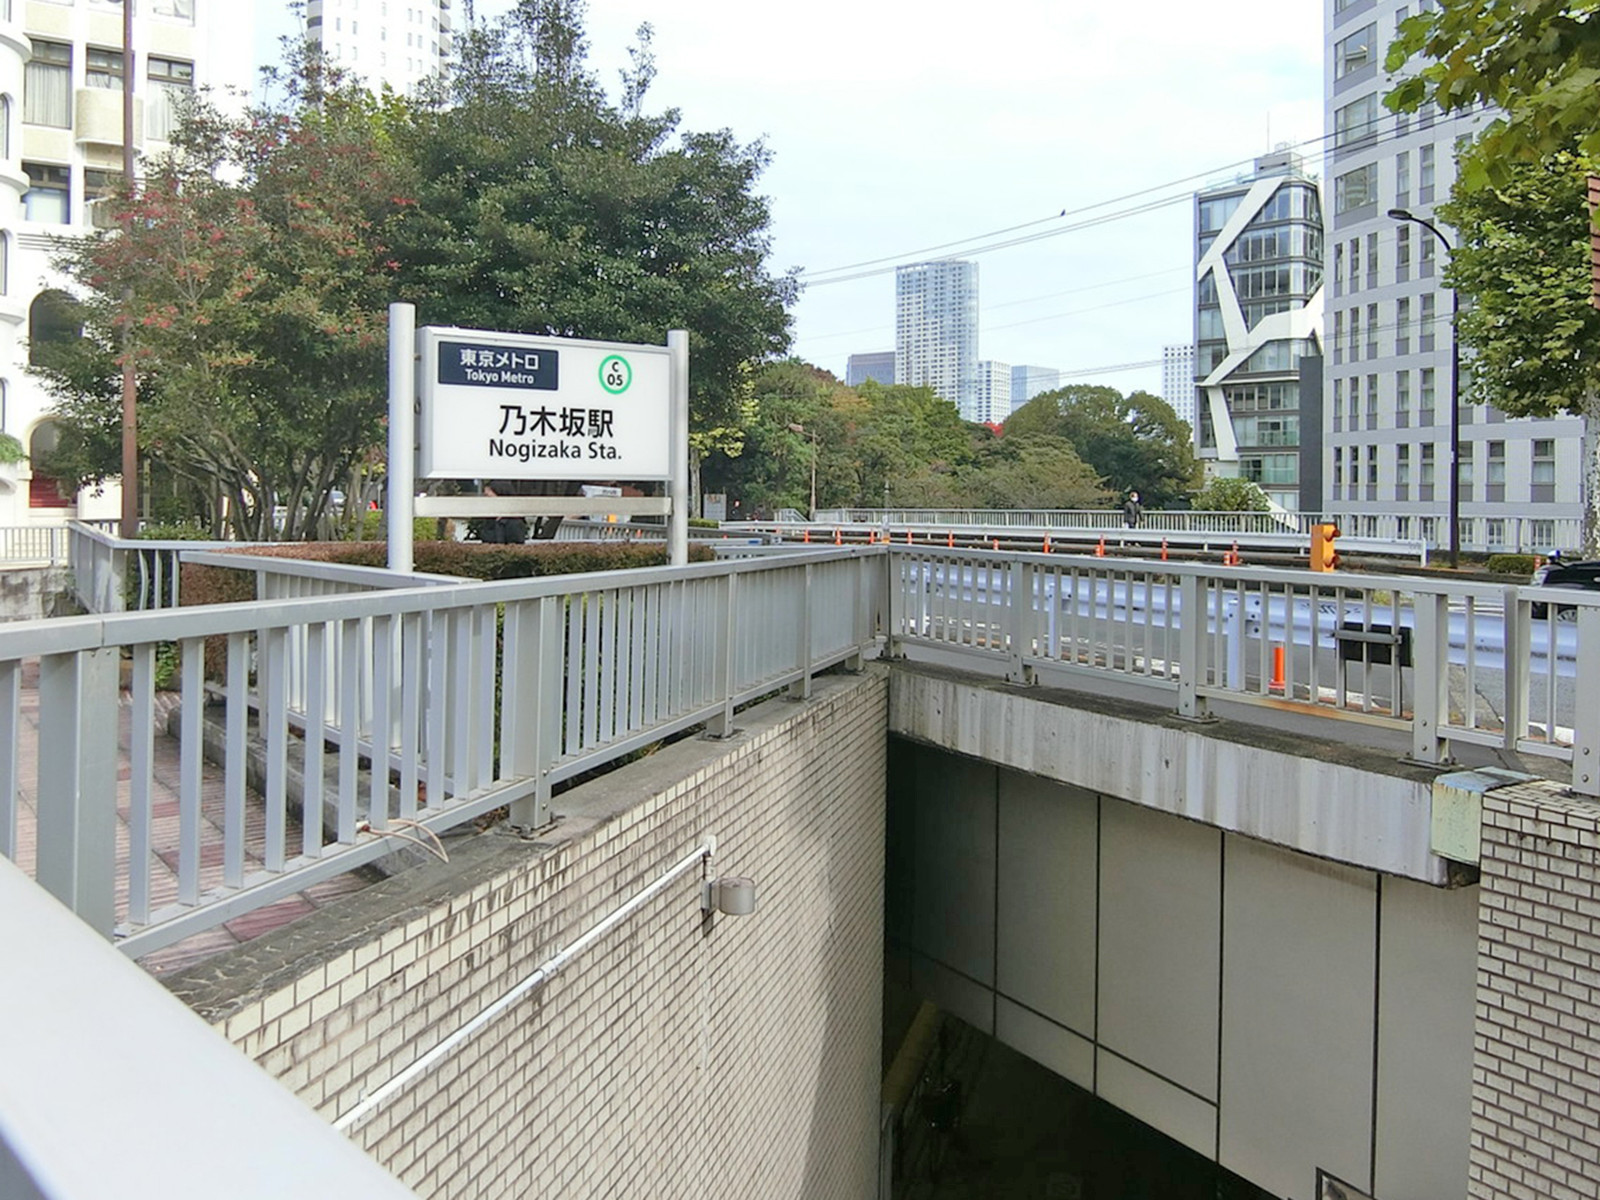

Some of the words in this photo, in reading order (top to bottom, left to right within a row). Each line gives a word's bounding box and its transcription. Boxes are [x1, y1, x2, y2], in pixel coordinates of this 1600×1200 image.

[460, 348, 539, 370] 東京メトロ
[611, 361, 619, 372] C
[465, 368, 498, 384] Tokyo
[501, 371, 534, 384] Metro
[607, 374, 623, 387] 05
[499, 405, 614, 438] 乃木坂駅
[489, 439, 581, 462] Nogizaka
[588, 442, 622, 460] Sta.
